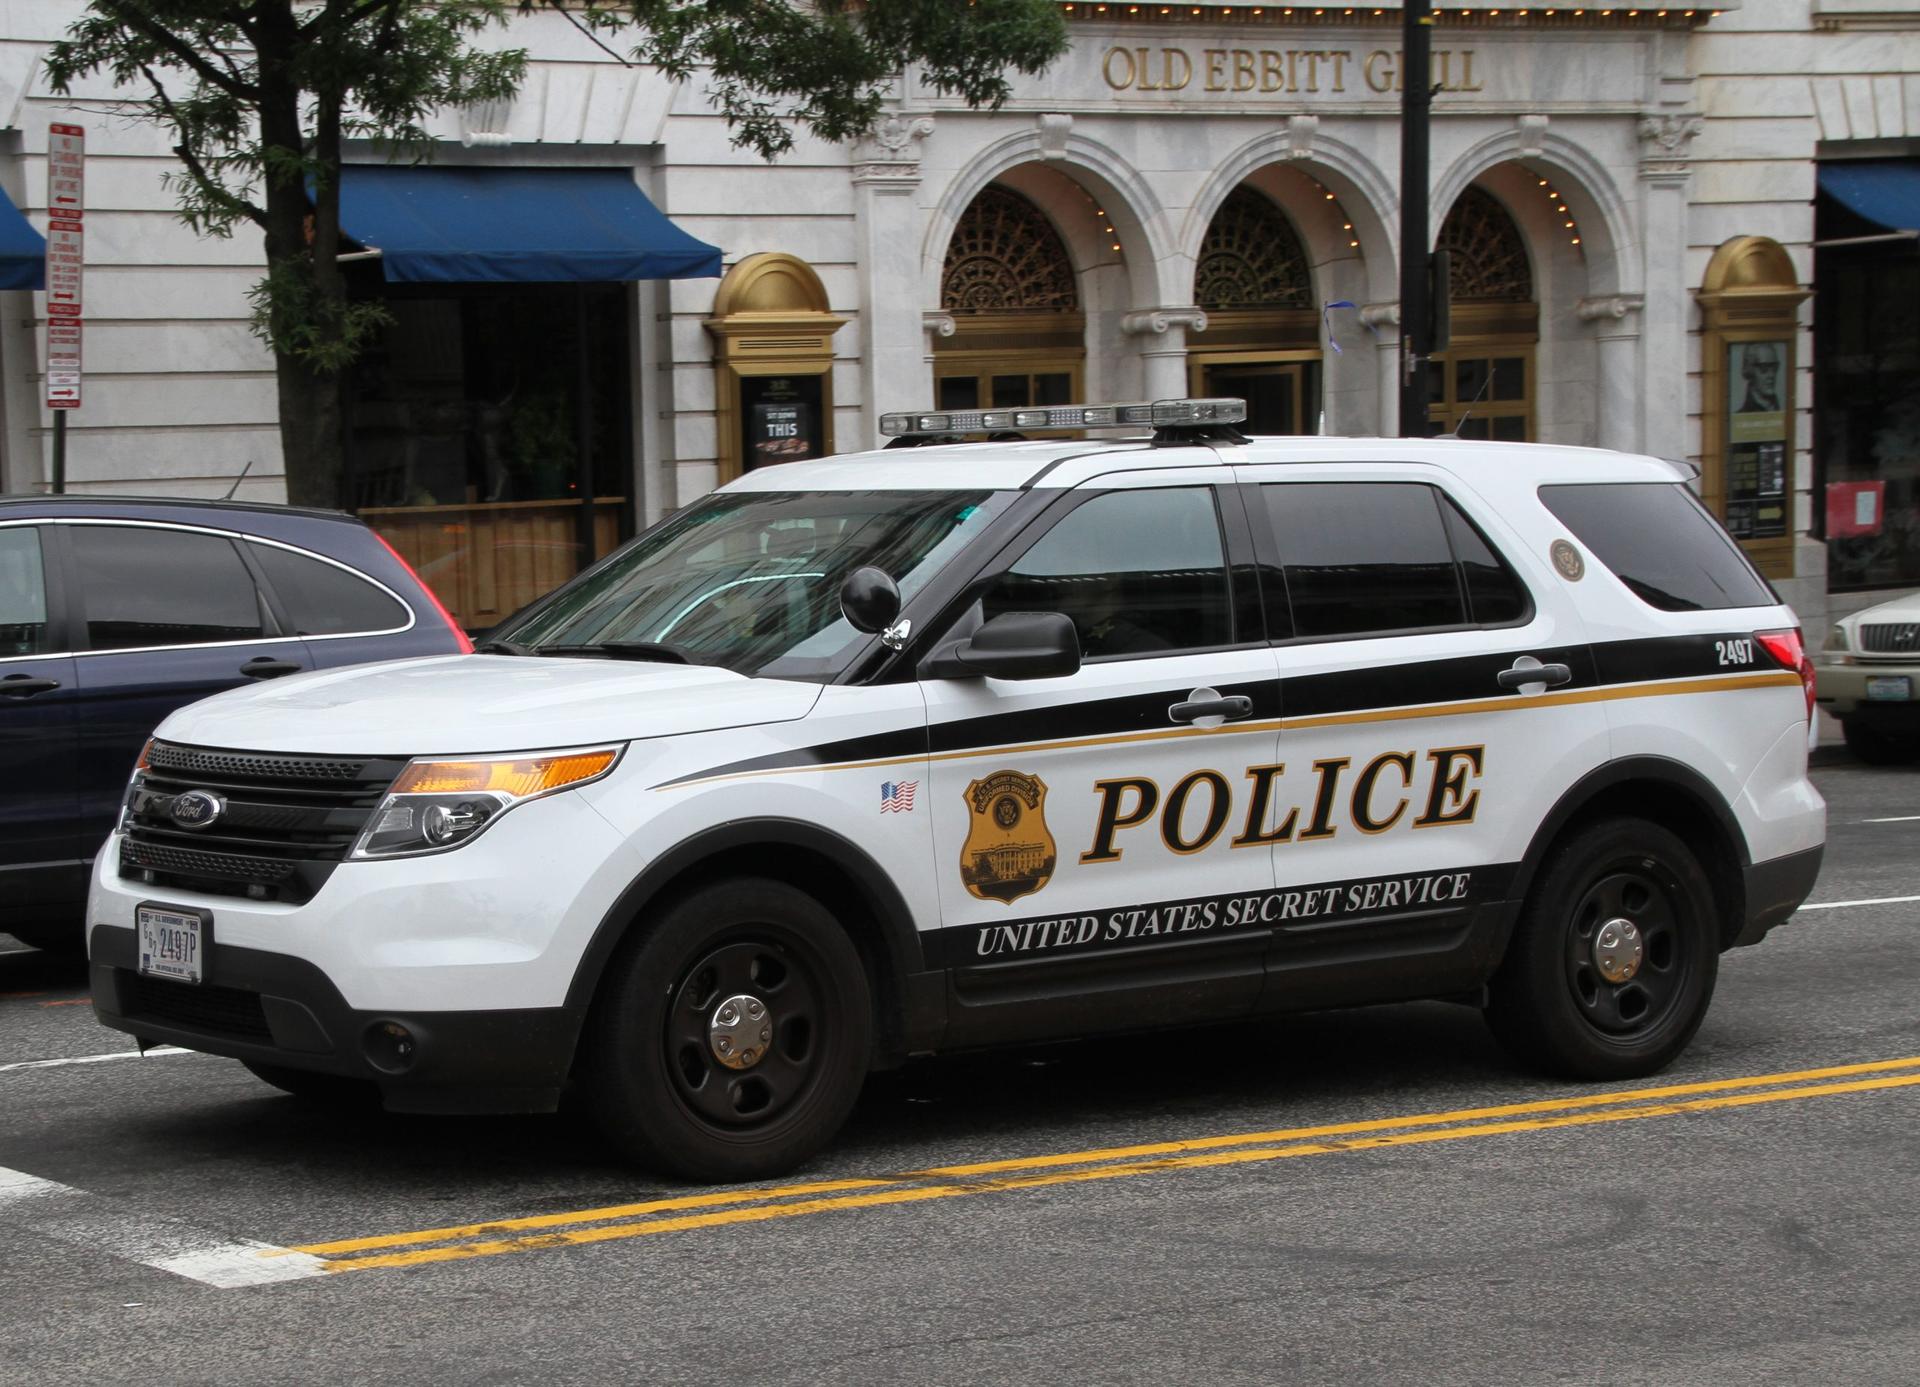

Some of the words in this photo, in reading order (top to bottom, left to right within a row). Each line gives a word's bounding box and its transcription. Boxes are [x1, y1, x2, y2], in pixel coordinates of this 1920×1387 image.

[1103, 46, 1192, 91] OLD
[1203, 49, 1351, 93] EBBITT
[1363, 50, 1484, 93] GLL
[766, 423, 797, 437] THIS
[1715, 639, 1754, 666] 2497
[175, 795, 205, 818] Ford
[1079, 744, 1485, 865] POLICE
[977, 916, 1098, 956] UNITED
[1104, 902, 1217, 940] STATES
[1223, 887, 1342, 927] SECRET
[1344, 873, 1471, 912] SERVICE
[160, 927, 196, 963] 2497P
